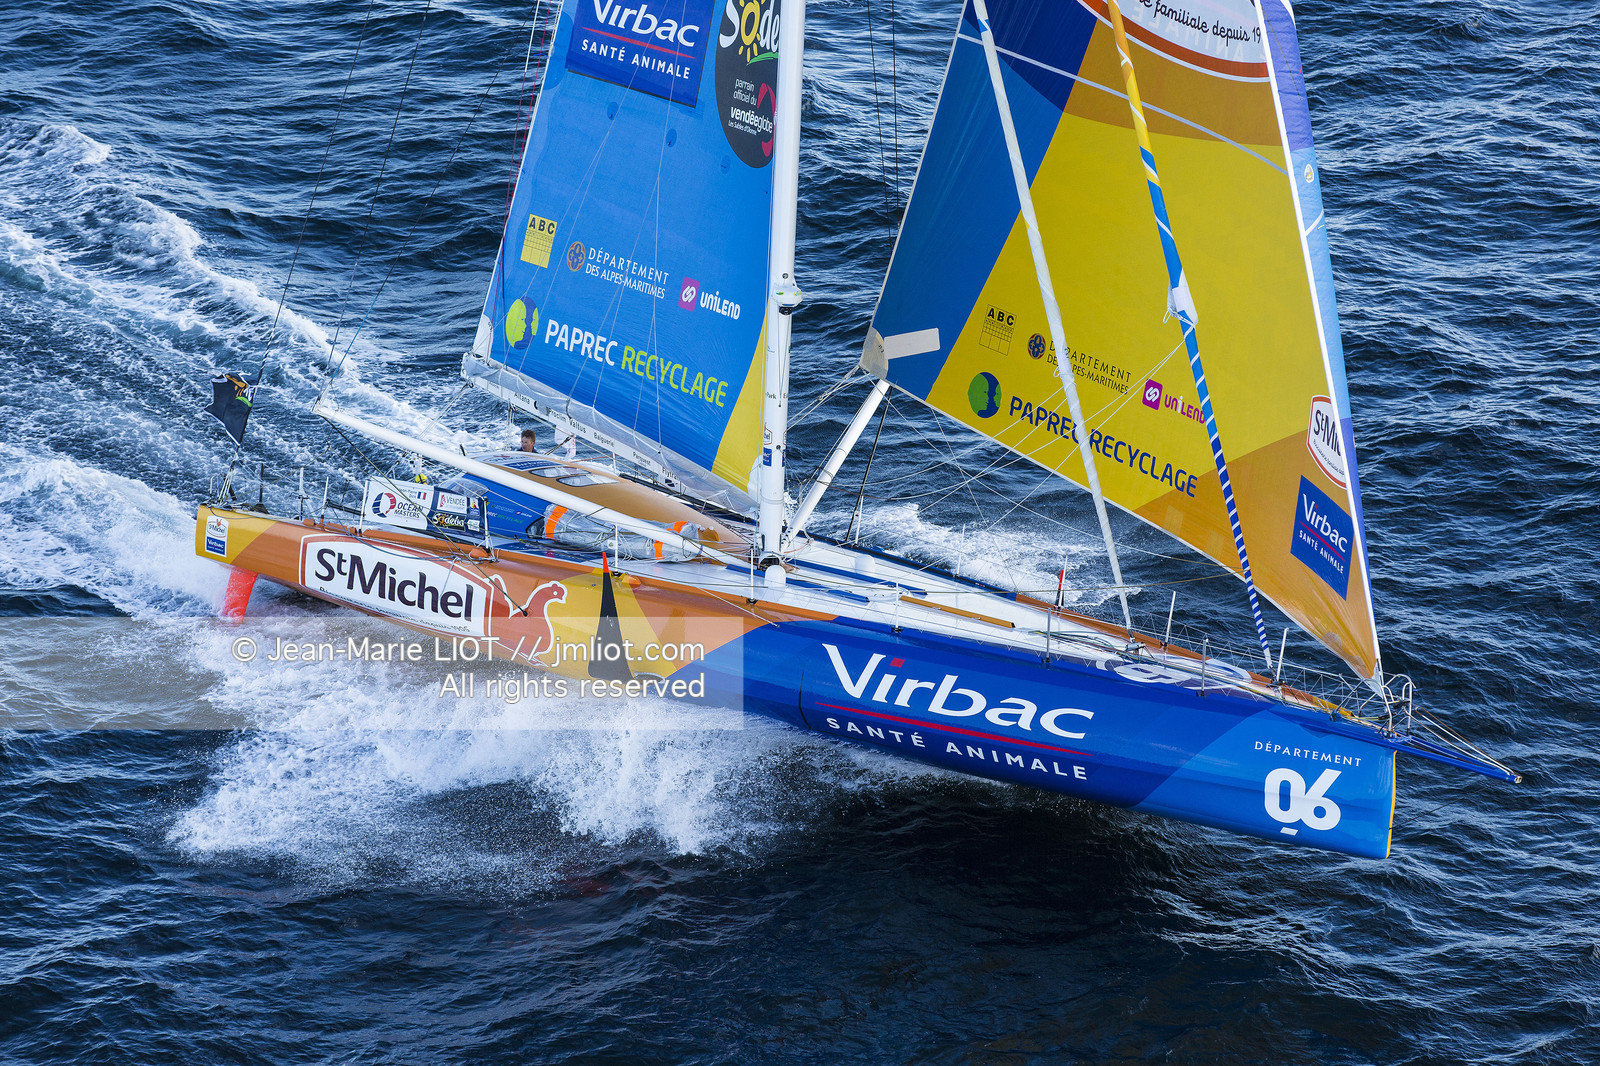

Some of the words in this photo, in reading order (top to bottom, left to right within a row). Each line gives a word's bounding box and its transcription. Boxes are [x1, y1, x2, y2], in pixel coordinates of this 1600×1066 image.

[593, 0, 699, 47] Virbac
[1154, 0, 1210, 33] familiale
[1212, 20, 1251, 47] depuis
[581, 39, 625, 62] SANTÉ
[632, 53, 691, 80] ANIMALE
[733, 89, 750, 103] officiel
[750, 95, 757, 106] du
[735, 78, 755, 92] parrain
[585, 263, 601, 278] DES
[600, 269, 666, 300] ALPES-MARITIMES
[588, 246, 669, 286] DÉPARTEMENT
[544, 318, 619, 367] PAPREC
[621, 345, 729, 408] RECYCLAGE
[1089, 428, 1198, 498] RECYCLAGE
[394, 508, 420, 519] MASTERS
[446, 495, 465, 507] VENDÉE
[1302, 492, 1348, 553] Virbac
[1299, 529, 1319, 552] SANTÉ
[1319, 546, 1344, 575] ANIMALE
[822, 643, 1094, 740] Virbac
[826, 717, 925, 748] SANTÉ
[946, 740, 1088, 781] ANIMALE
[1254, 740, 1362, 768] DÉPARTEMENT
[1264, 767, 1342, 832] 06
